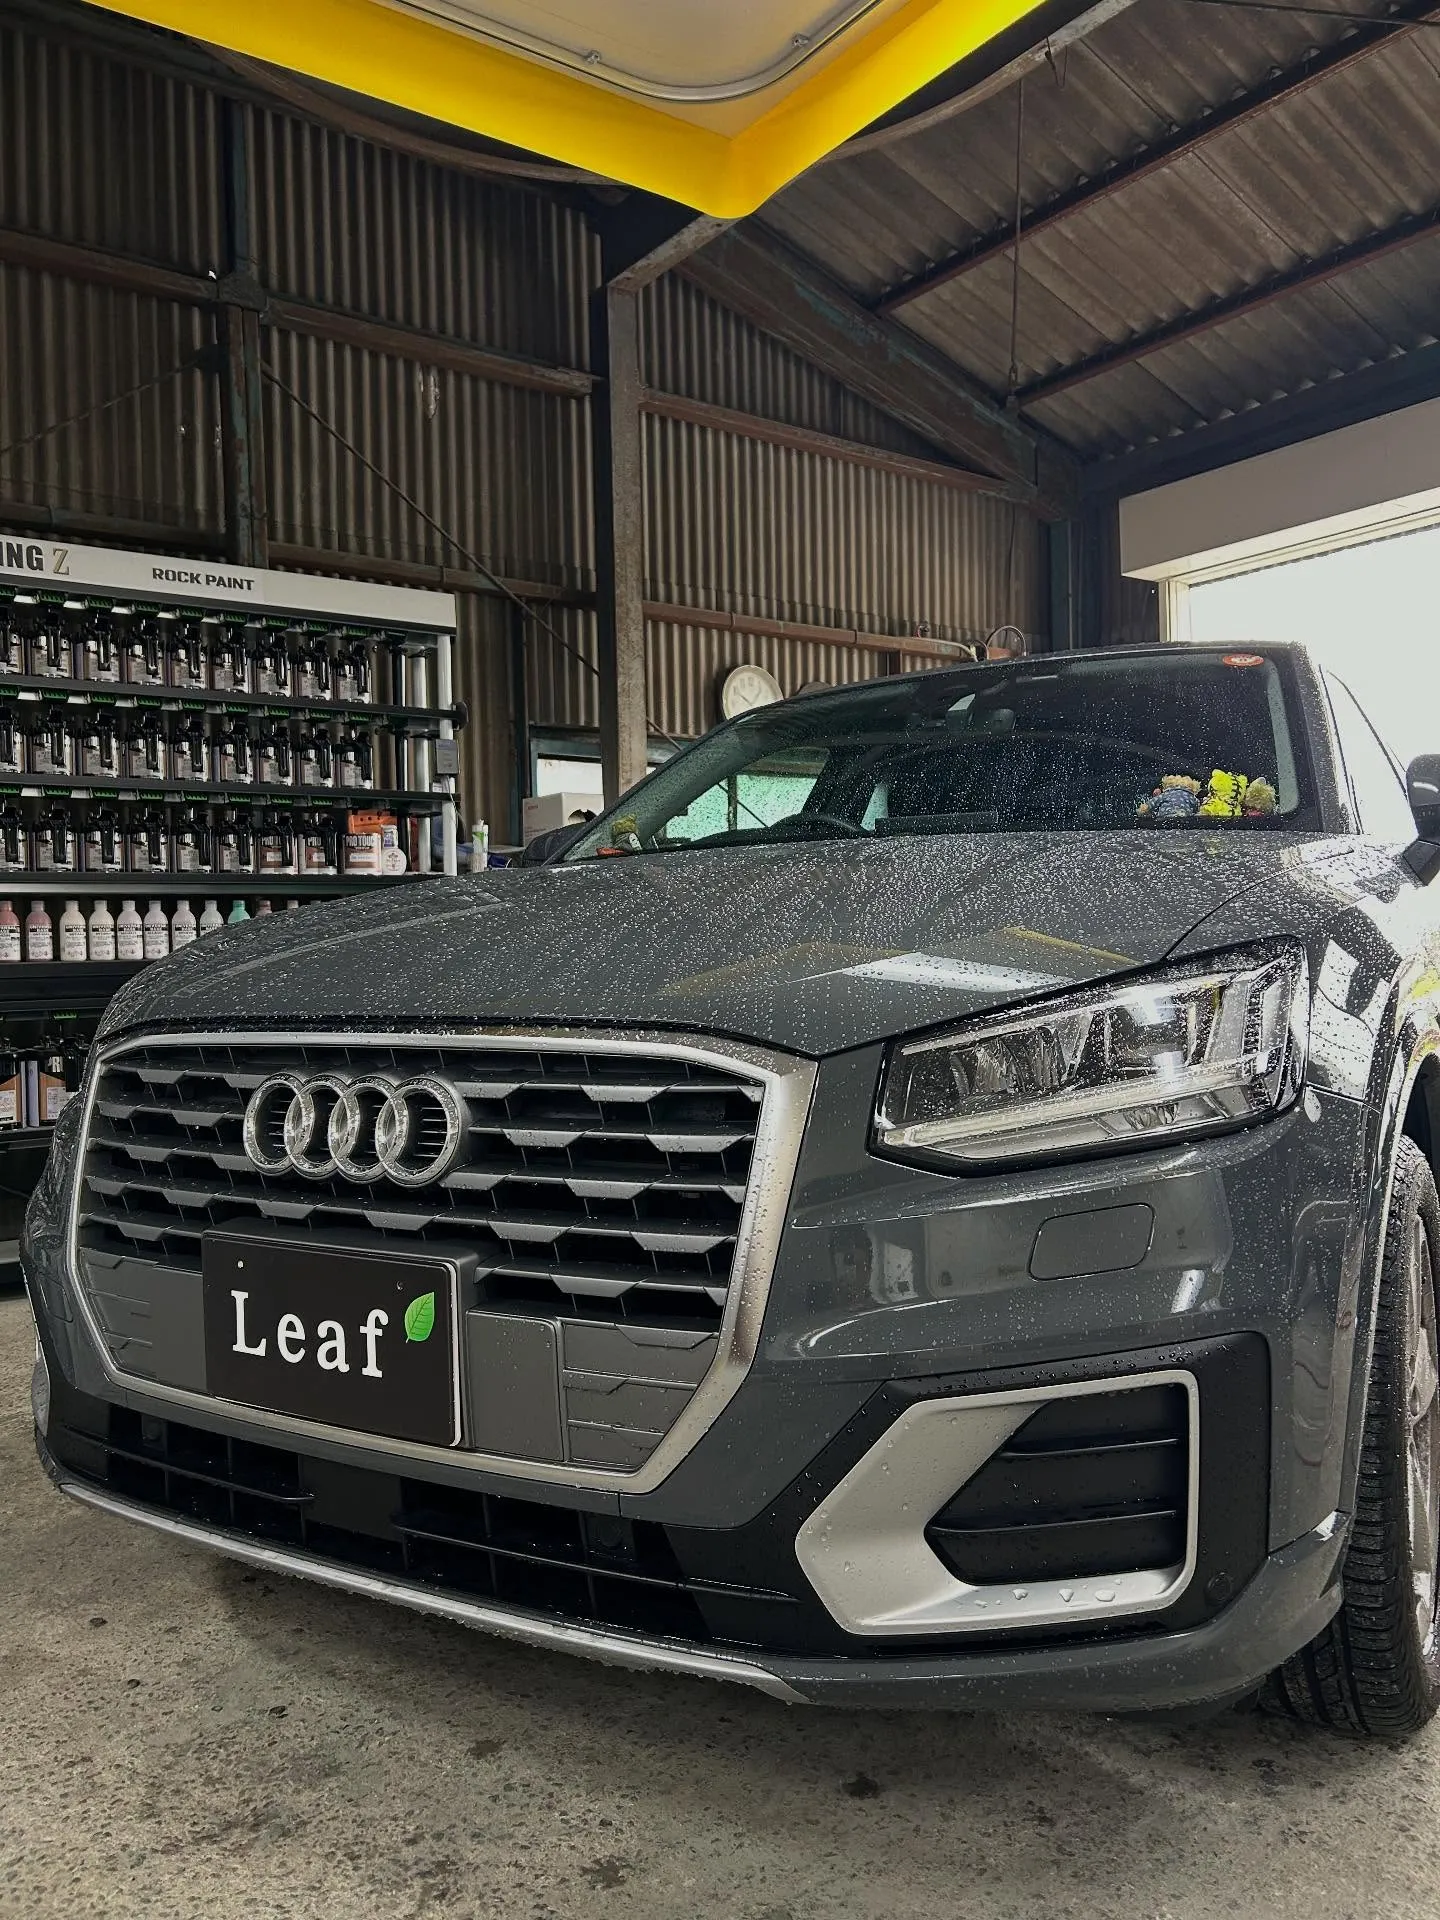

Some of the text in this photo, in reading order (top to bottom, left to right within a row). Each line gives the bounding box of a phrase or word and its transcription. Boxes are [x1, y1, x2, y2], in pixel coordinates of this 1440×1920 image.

[53, 548, 70, 575] Z
[152, 567, 255, 591] ROCK PAINT
[345, 835, 358, 847] PRO
[230, 1289, 389, 1378] Leaf
